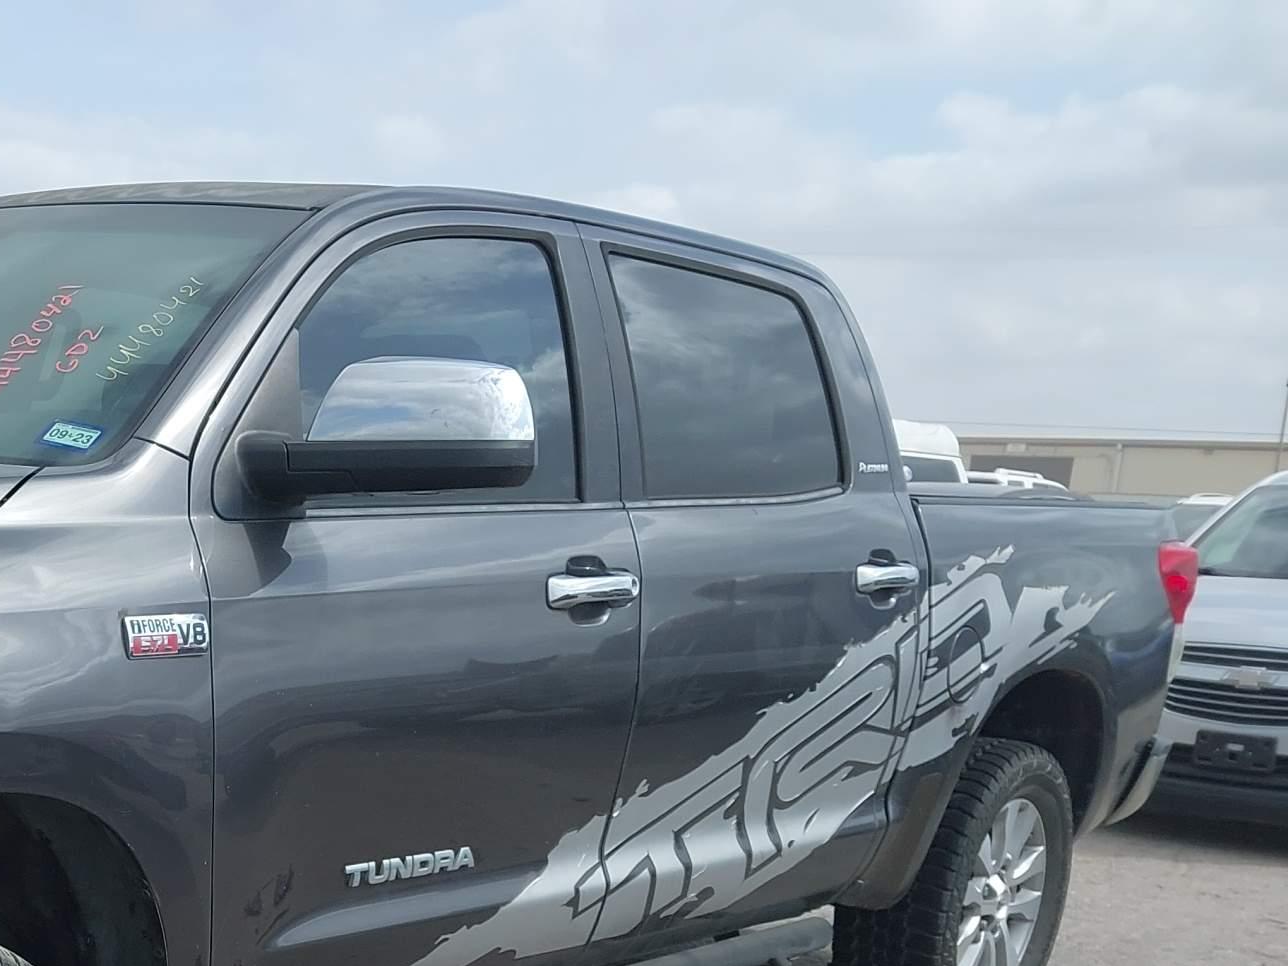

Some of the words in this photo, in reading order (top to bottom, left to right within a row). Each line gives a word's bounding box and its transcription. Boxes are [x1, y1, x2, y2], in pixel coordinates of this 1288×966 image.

[96, 276, 204, 381] 44480421
[178, 622, 207, 647] V8
[344, 846, 476, 889] TUNDRA
